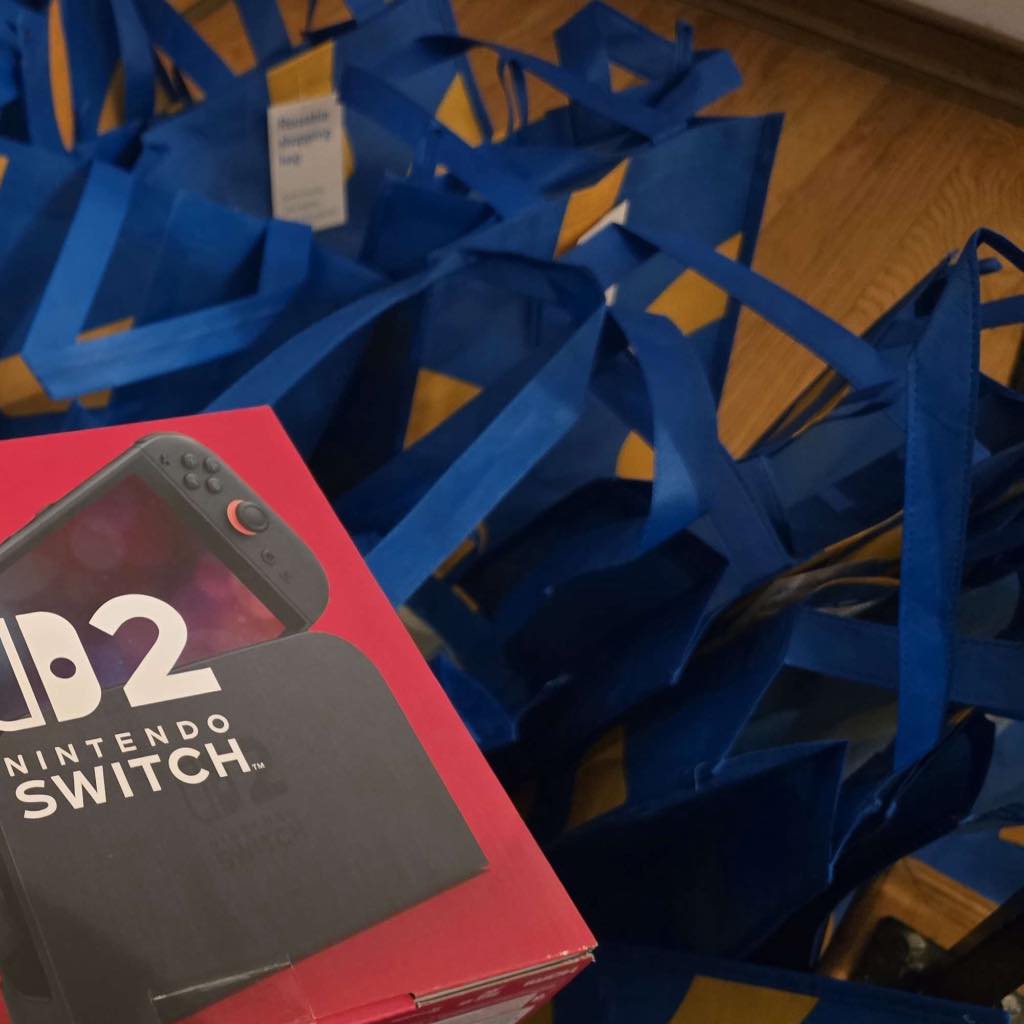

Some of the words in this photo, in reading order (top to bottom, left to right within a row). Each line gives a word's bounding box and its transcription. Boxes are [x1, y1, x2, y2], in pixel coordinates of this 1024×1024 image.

[89, 594, 222, 707] 2
[3, 714, 230, 777] NINTENDO
[15, 738, 251, 819] SWITCH
